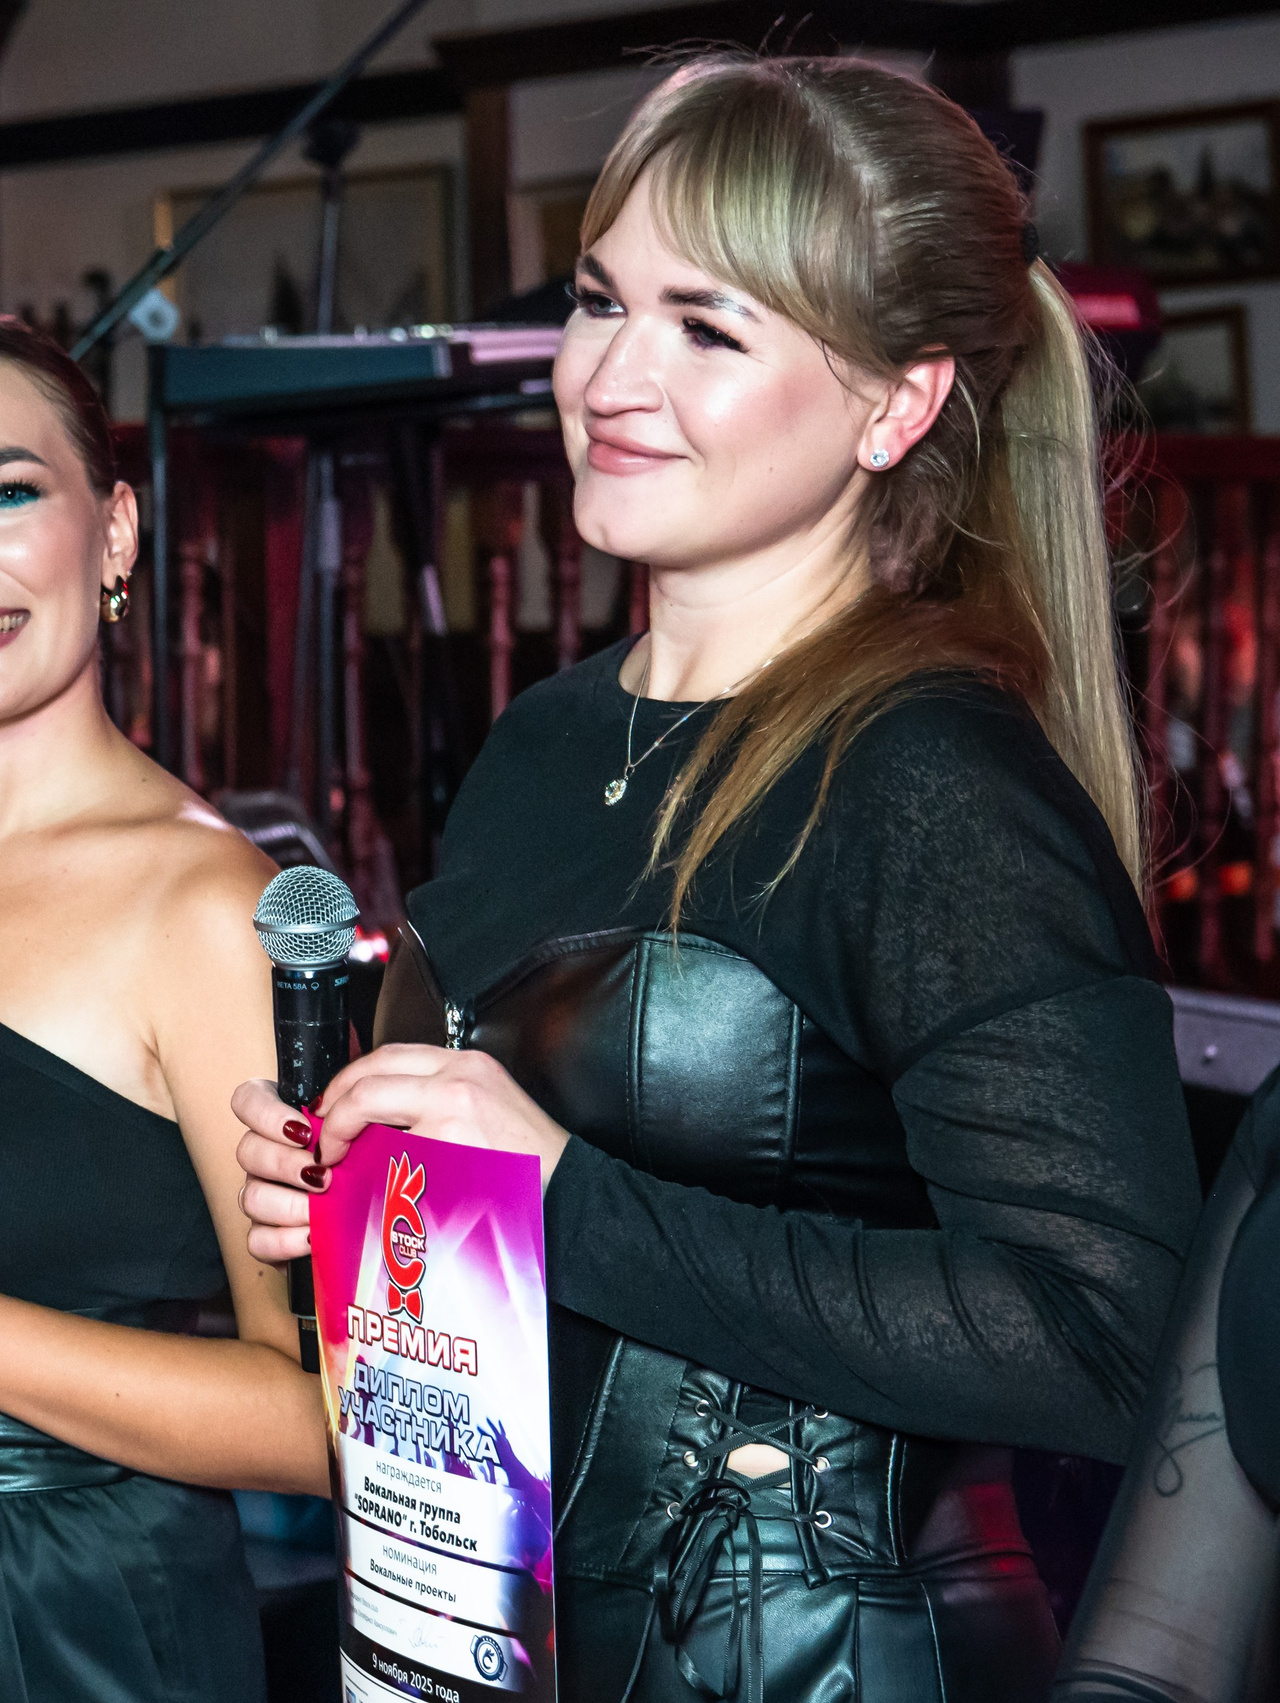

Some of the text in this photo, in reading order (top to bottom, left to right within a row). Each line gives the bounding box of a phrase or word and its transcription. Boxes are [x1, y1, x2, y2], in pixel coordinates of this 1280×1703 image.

[391, 1230, 426, 1252] STOCK
[399, 1245, 418, 1259] CLUB
[347, 1303, 478, 1376] ПРЕМИЯ
[354, 1360, 471, 1426] ДИПЛОМ
[338, 1385, 503, 1467] УЧАСТНИКА
[364, 1475, 461, 1525] Вокальная группа
[376, 1460, 442, 1494] награждается
[354, 1492, 478, 1552] "SOPRANO" г. Тобольск
[370, 1558, 457, 1603] Вокальные проекты
[382, 1545, 437, 1576] номинация
[372, 1652, 460, 1703] 9 ноября 2025 года
